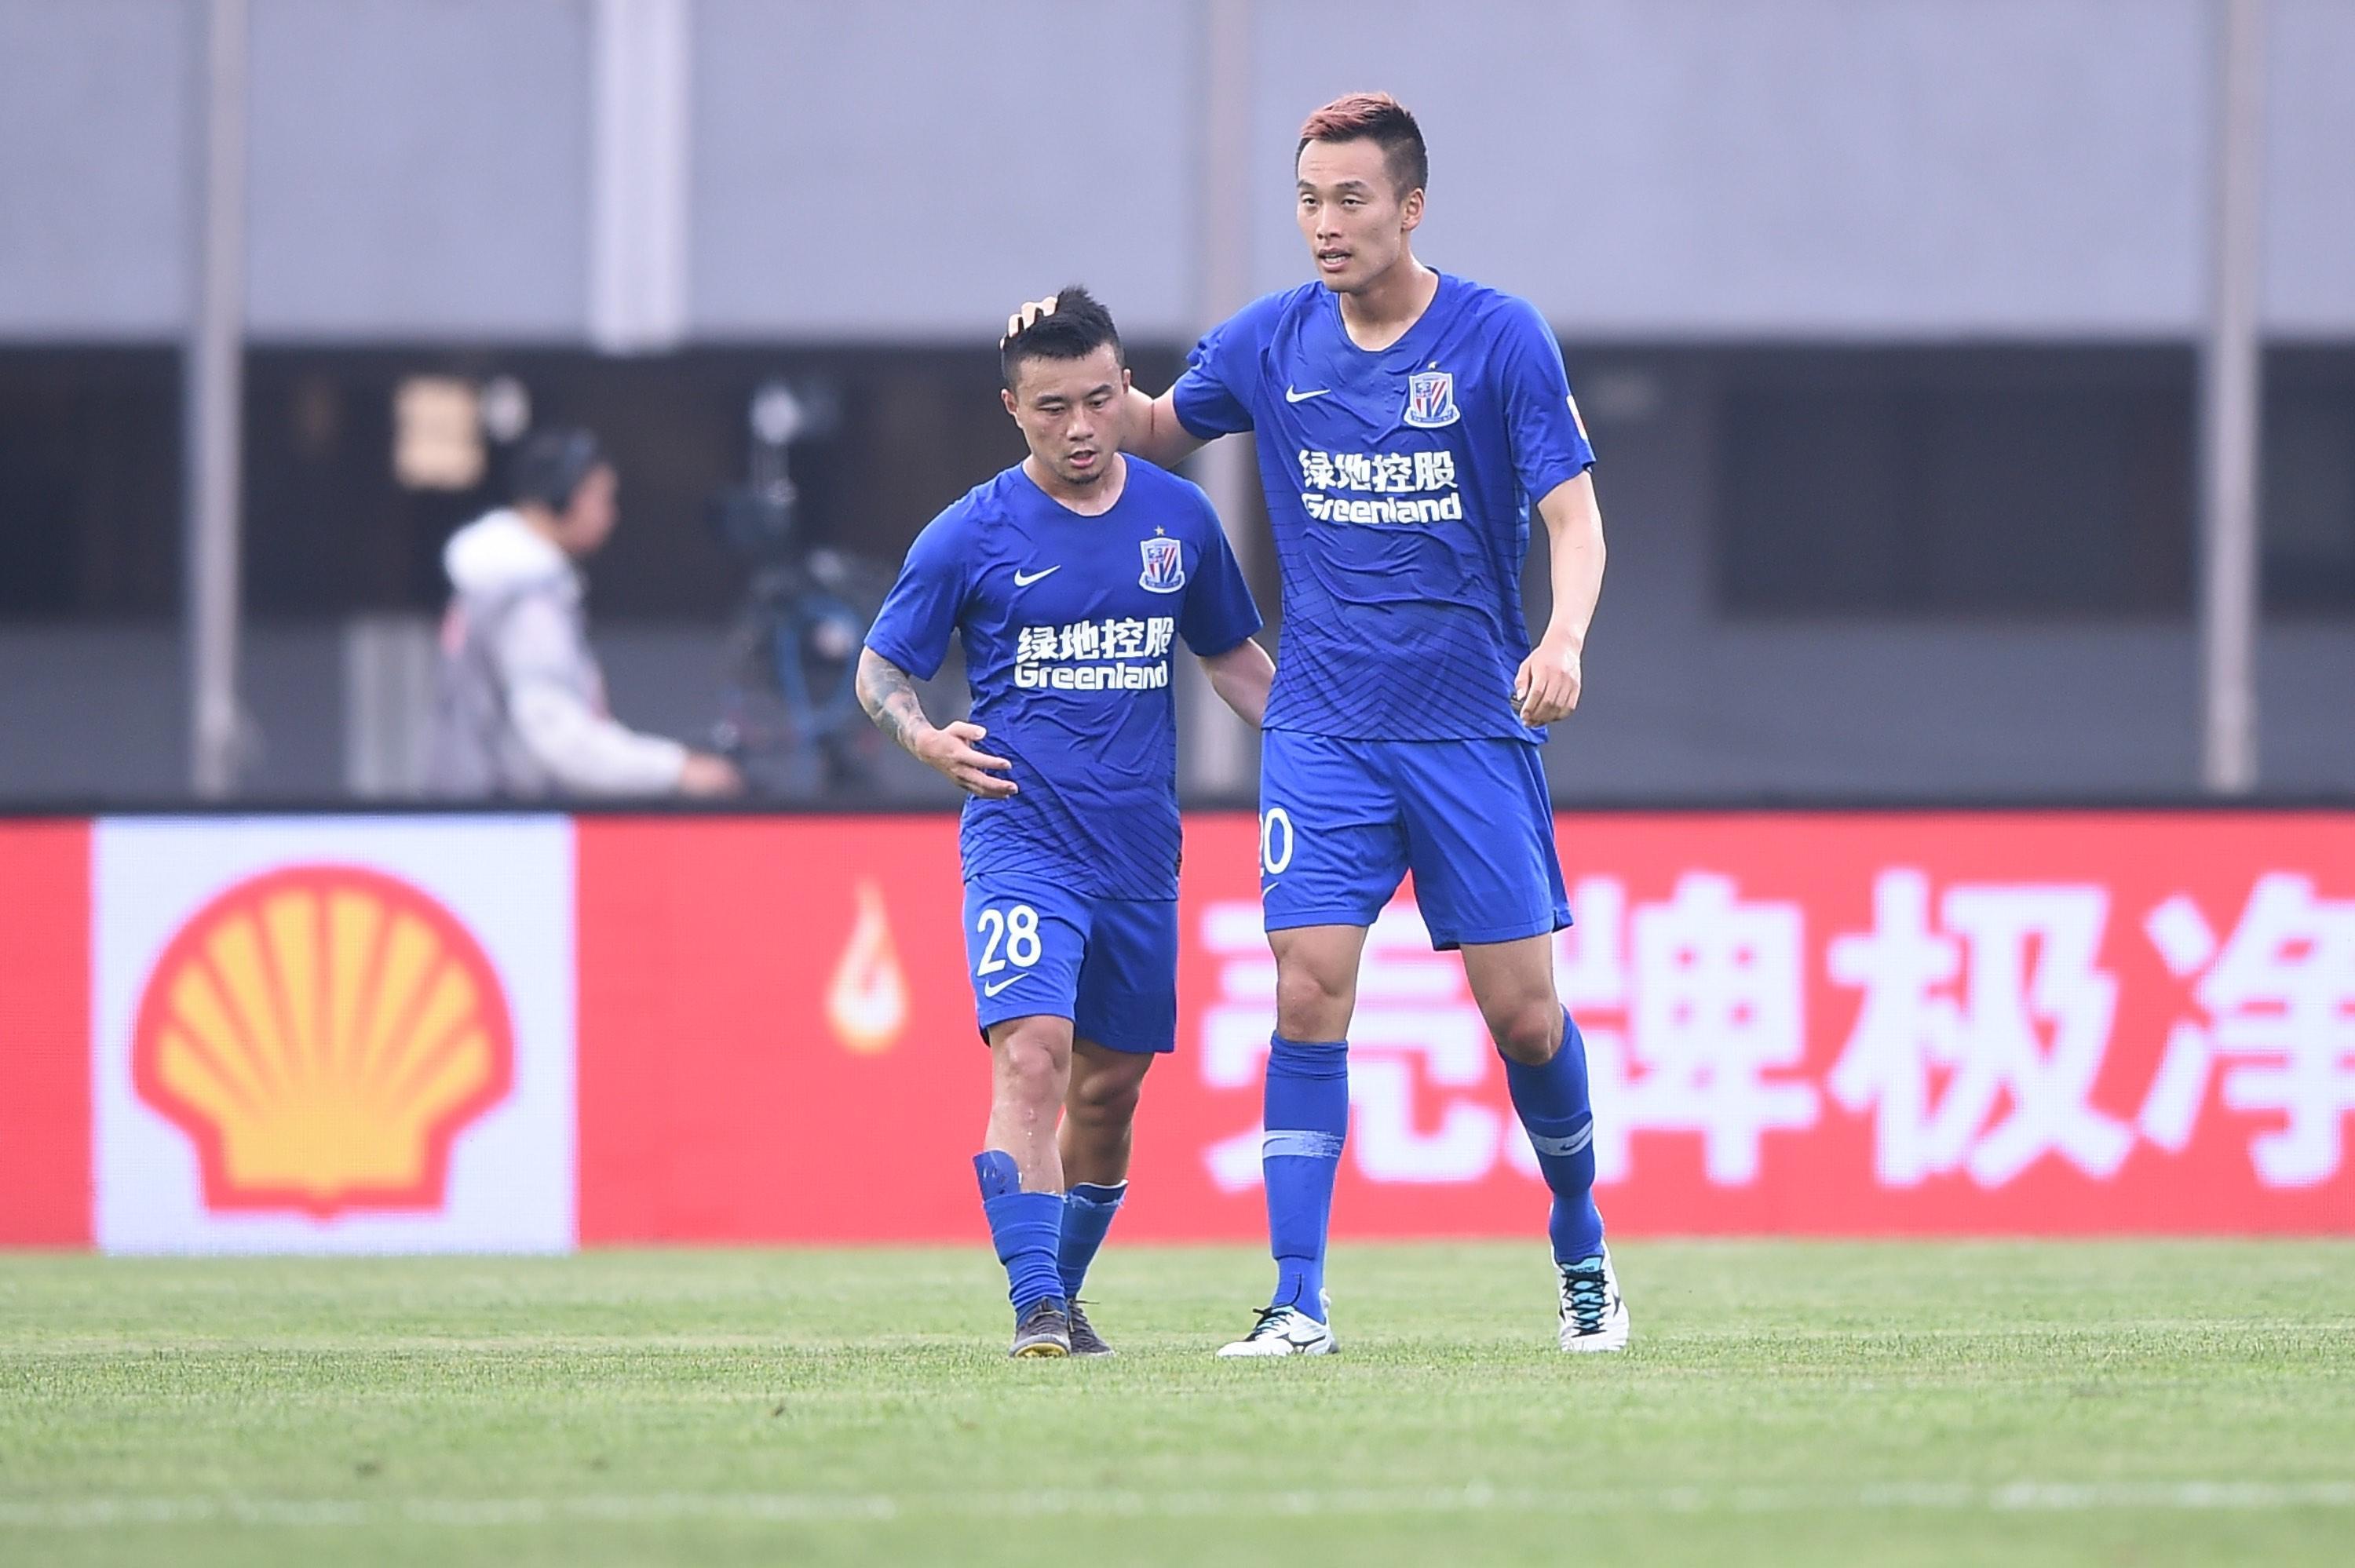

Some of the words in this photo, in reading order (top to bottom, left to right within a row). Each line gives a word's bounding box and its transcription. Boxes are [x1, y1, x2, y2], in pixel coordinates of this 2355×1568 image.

[1298, 450, 1458, 493] 绿地控股
[1301, 492, 1462, 524] Greenland
[1016, 617, 1174, 663] 绿地控股
[1013, 660, 1168, 690] Greenland
[1259, 808, 1293, 875] 0
[977, 904, 1042, 976] 28
